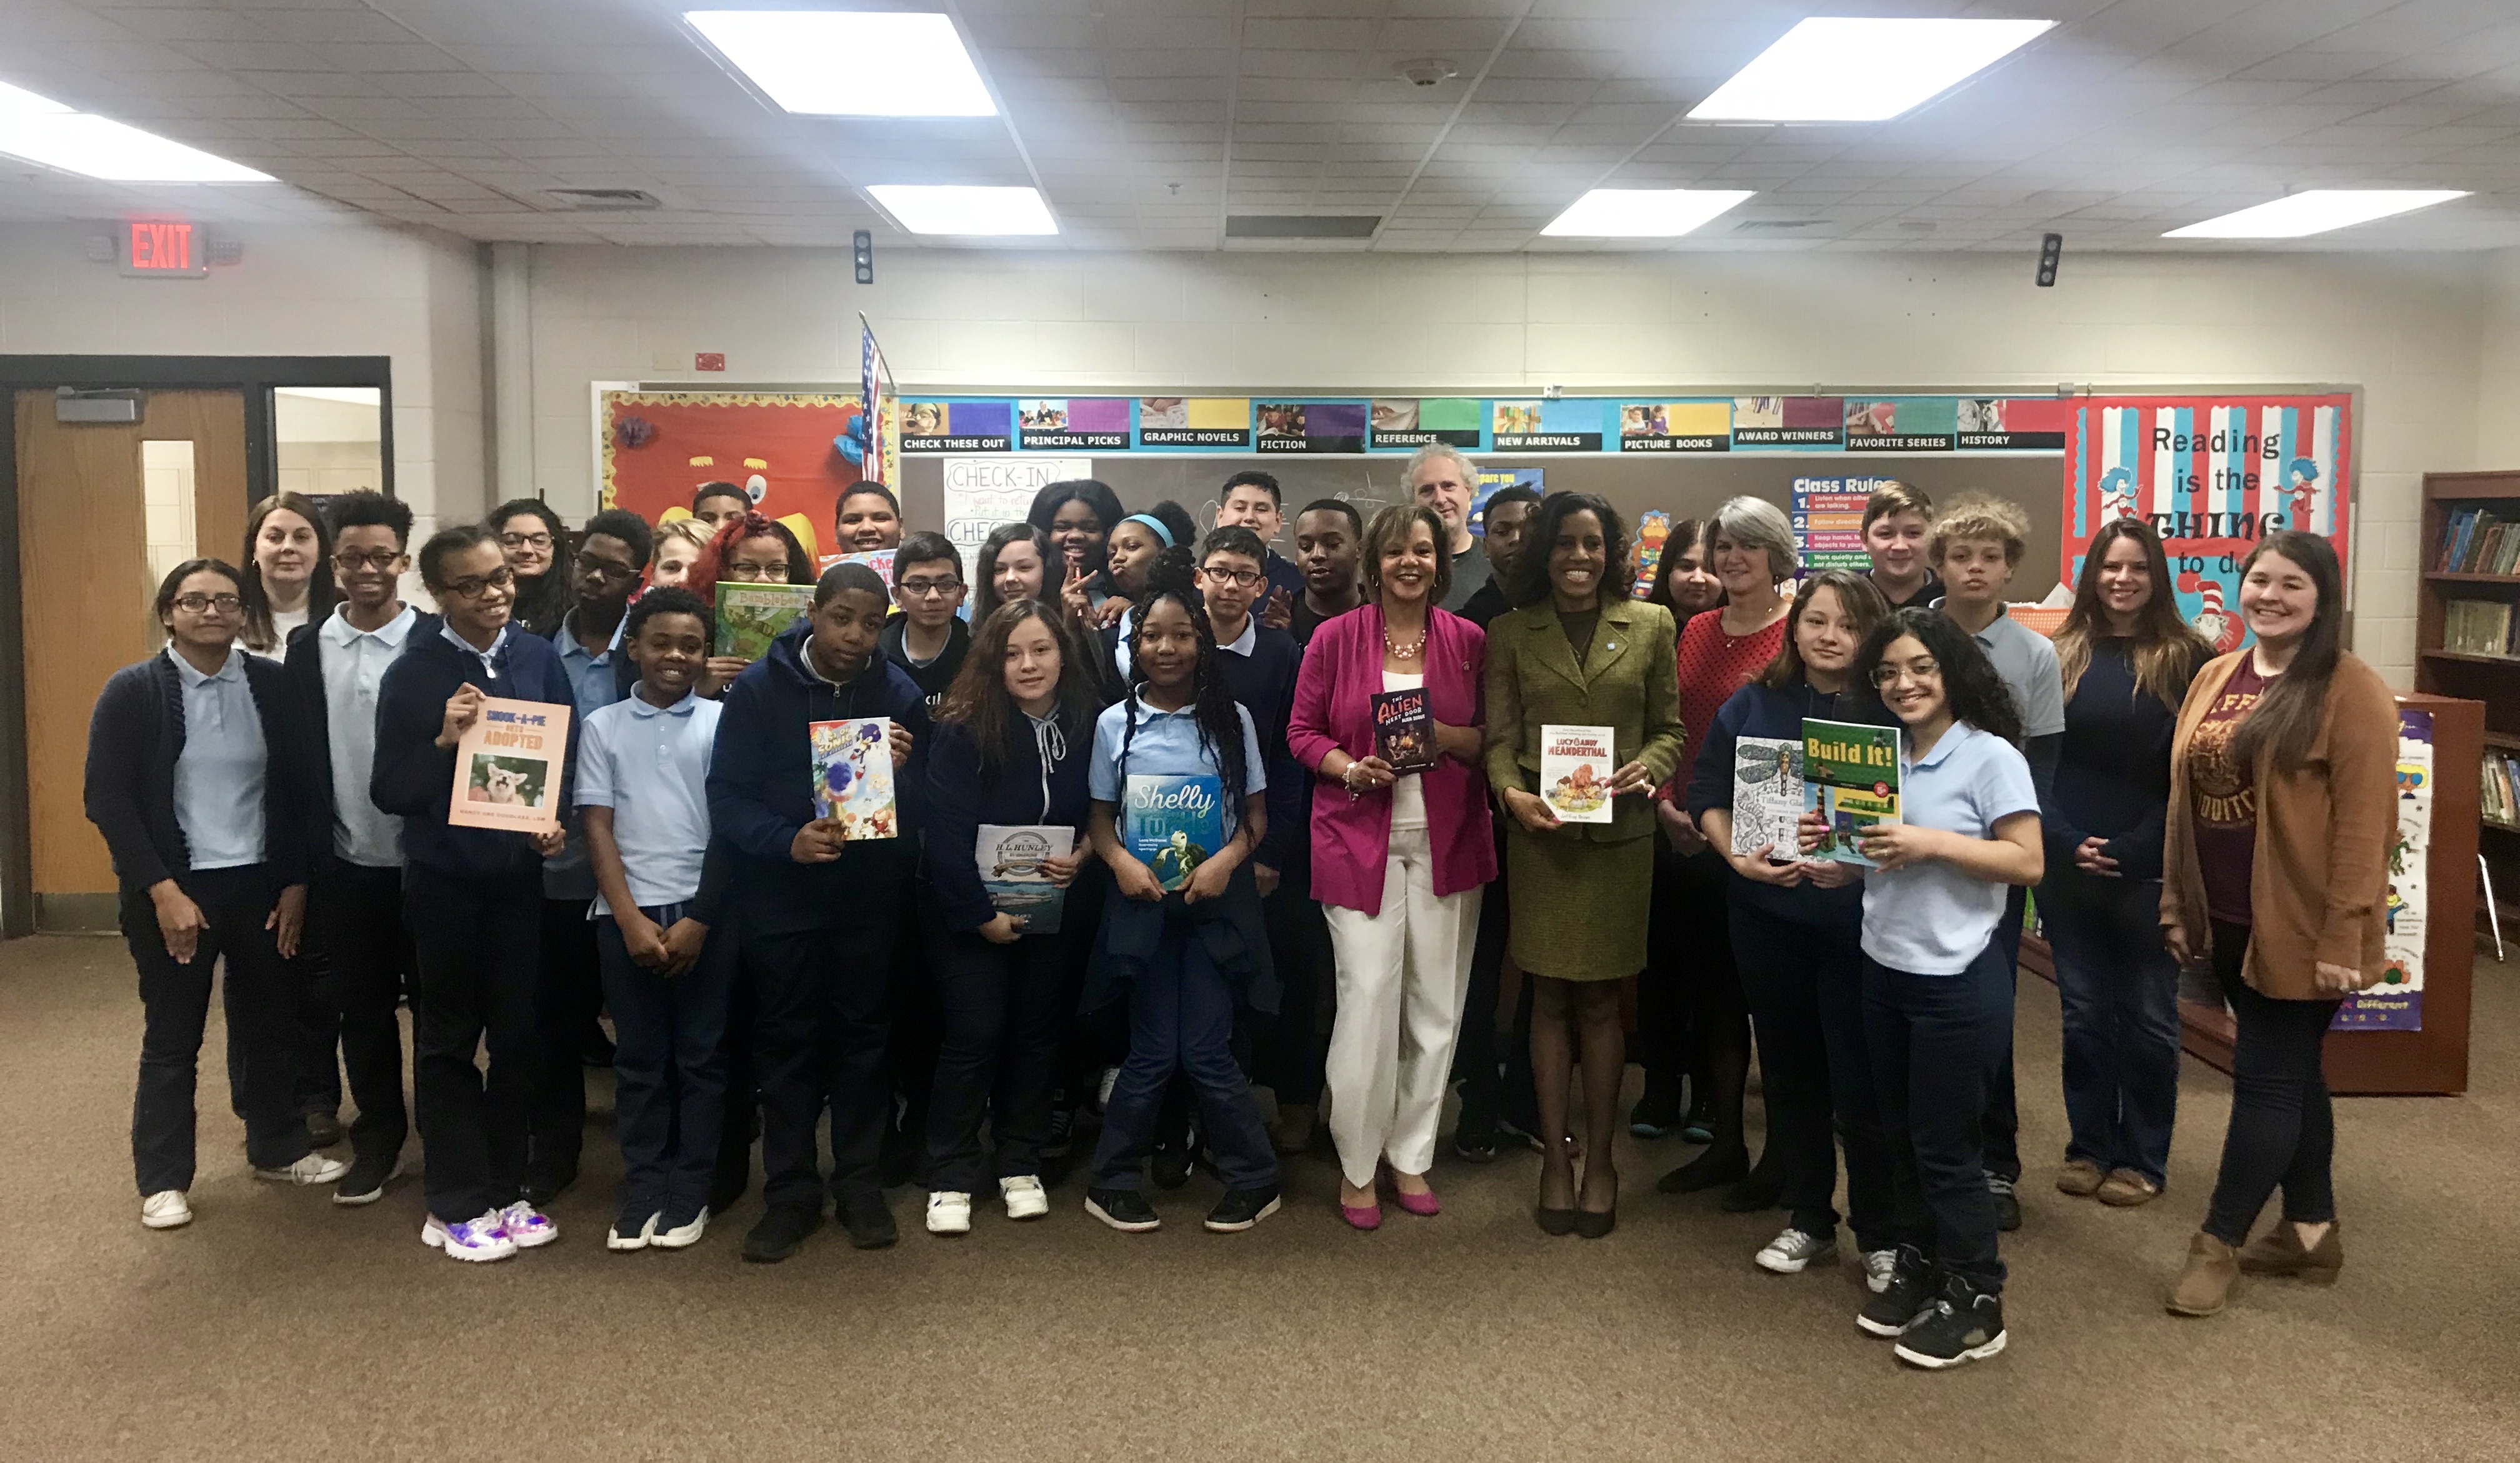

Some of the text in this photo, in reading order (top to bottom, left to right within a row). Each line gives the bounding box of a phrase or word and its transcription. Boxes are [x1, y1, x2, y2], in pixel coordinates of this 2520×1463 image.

[131, 224, 191, 269] EXIT
[1024, 436, 1121, 445] PRINCIPAL PICKS
[1144, 432, 1239, 442] GRAPHIC NOVELS
[1375, 434, 1437, 443] REFERENCE
[1498, 436, 1581, 446] NEW ARRIVALS
[1738, 431, 1834, 441] AWARD WINNERS
[1961, 436, 2010, 445] HISTORY
[904, 439, 1005, 449] CHECK THESE OUT
[1261, 440, 1306, 449] FICTION
[1625, 439, 1712, 449] PICTURE BOOKS
[1850, 438, 1946, 447] FAVORITE SERIES
[2152, 427, 2280, 459] Reading
[953, 466, 1049, 487] CHECK-IN
[2178, 467, 2259, 492] is the
[1794, 479, 1839, 492] Class
[1798, 497, 1810, 508] 1.
[1794, 516, 1810, 528] 2.
[2178, 552, 2204, 574] to
[1377, 694, 1422, 724] ALIEN
[1385, 707, 1422, 726] NEXT DOOR
[483, 730, 543, 750] ADOPTED
[1548, 746, 1607, 757] NEANDERTHAL
[1808, 737, 1892, 767] Build It!
[1134, 785, 1215, 819] Shelly
[1761, 796, 1787, 807] Tiffany
